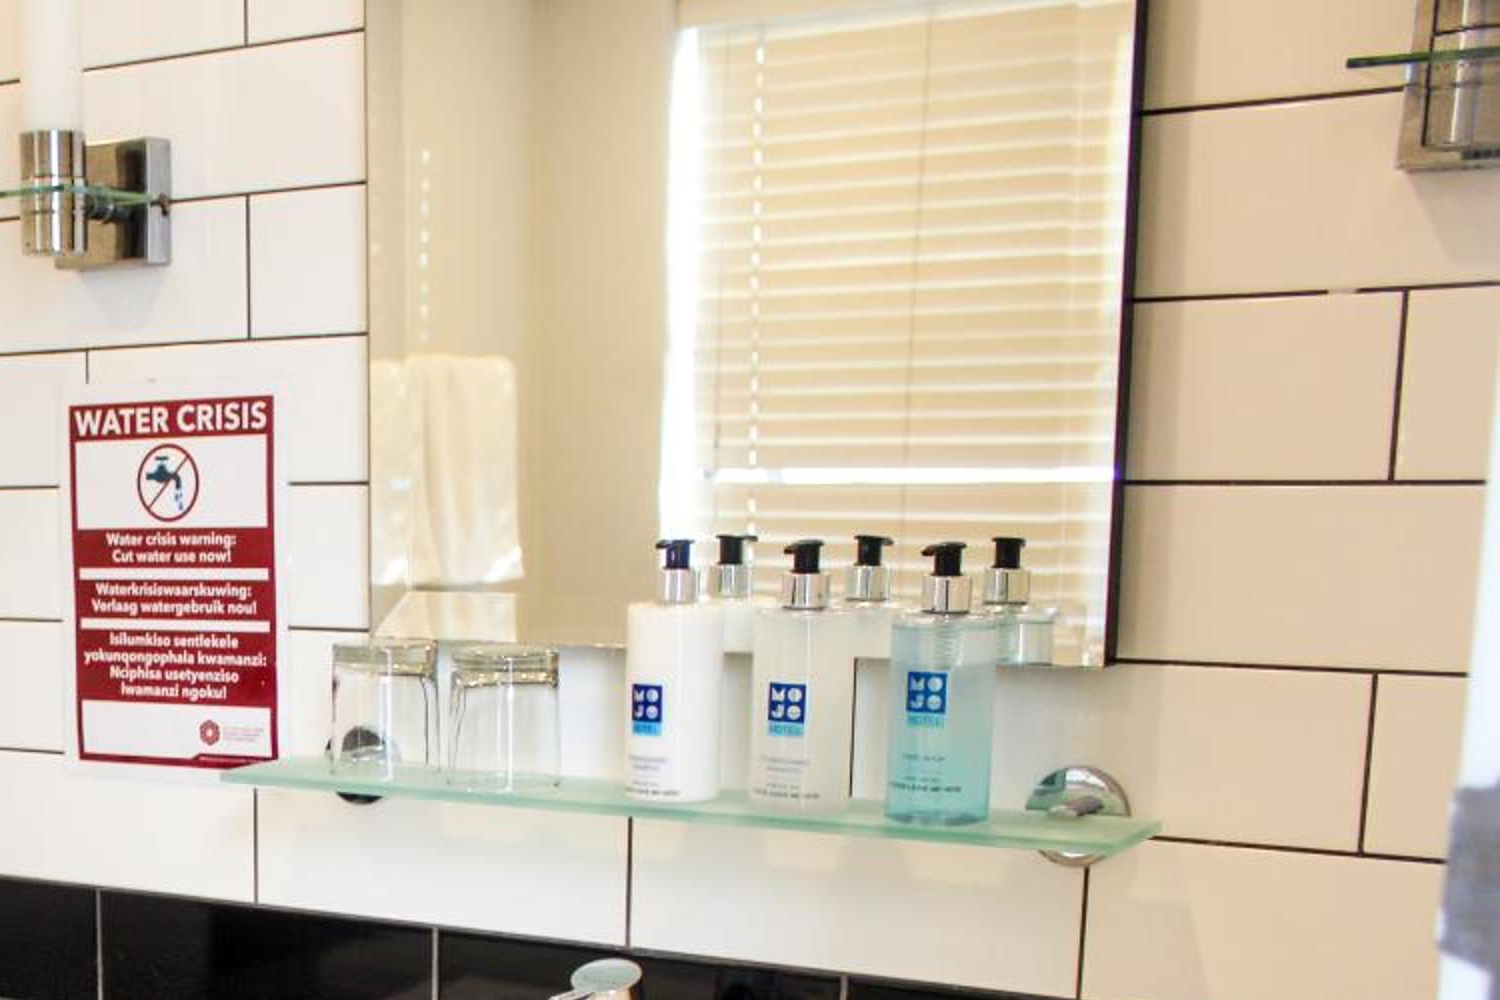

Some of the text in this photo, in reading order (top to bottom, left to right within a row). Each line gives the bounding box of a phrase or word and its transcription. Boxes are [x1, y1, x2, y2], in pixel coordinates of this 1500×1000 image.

[74, 401, 267, 436] WATER CRISIS
[106, 533, 237, 548] Water crisis warning:
[111, 549, 232, 564] Cut water use now!
[95, 582, 252, 600] Waterkrisiswaarskuwing:
[92, 599, 258, 616] Verlaag watergebruik nou!
[109, 632, 171, 647] Isilumkiso
[197, 651, 267, 668] kwamanzi:
[182, 684, 227, 703] ngoku!
